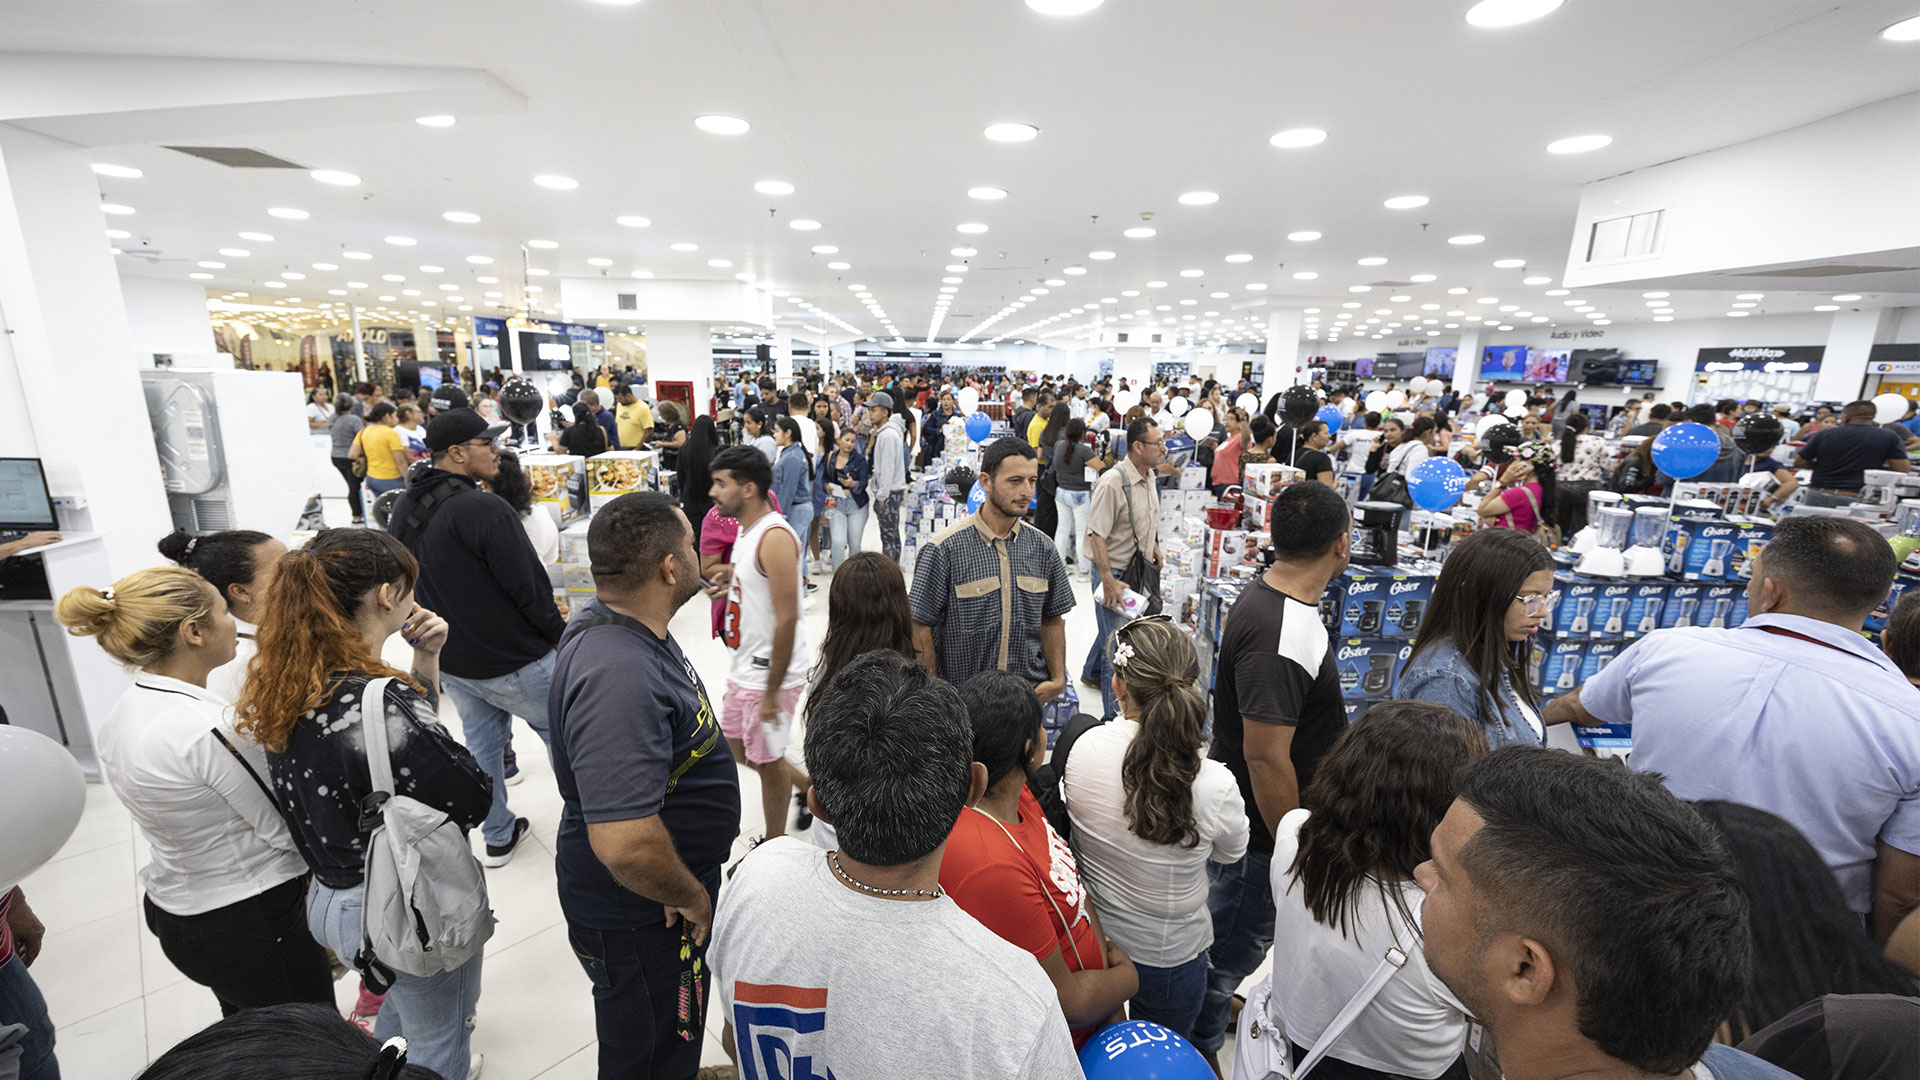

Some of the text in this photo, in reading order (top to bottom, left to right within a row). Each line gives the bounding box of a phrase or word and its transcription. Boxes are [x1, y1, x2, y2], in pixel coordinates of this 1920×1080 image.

[1550, 330, 1572, 340] Audio
[1702, 526, 1733, 537] Oster
[1348, 581, 1379, 596] Oster
[1389, 581, 1421, 596] Oster
[1570, 585, 1595, 597] Oster
[1604, 586, 1630, 597] Oster
[1639, 585, 1664, 597] Oster
[1674, 586, 1699, 598] Oster
[1708, 586, 1734, 598] Oster
[1338, 645, 1371, 661] Oster
